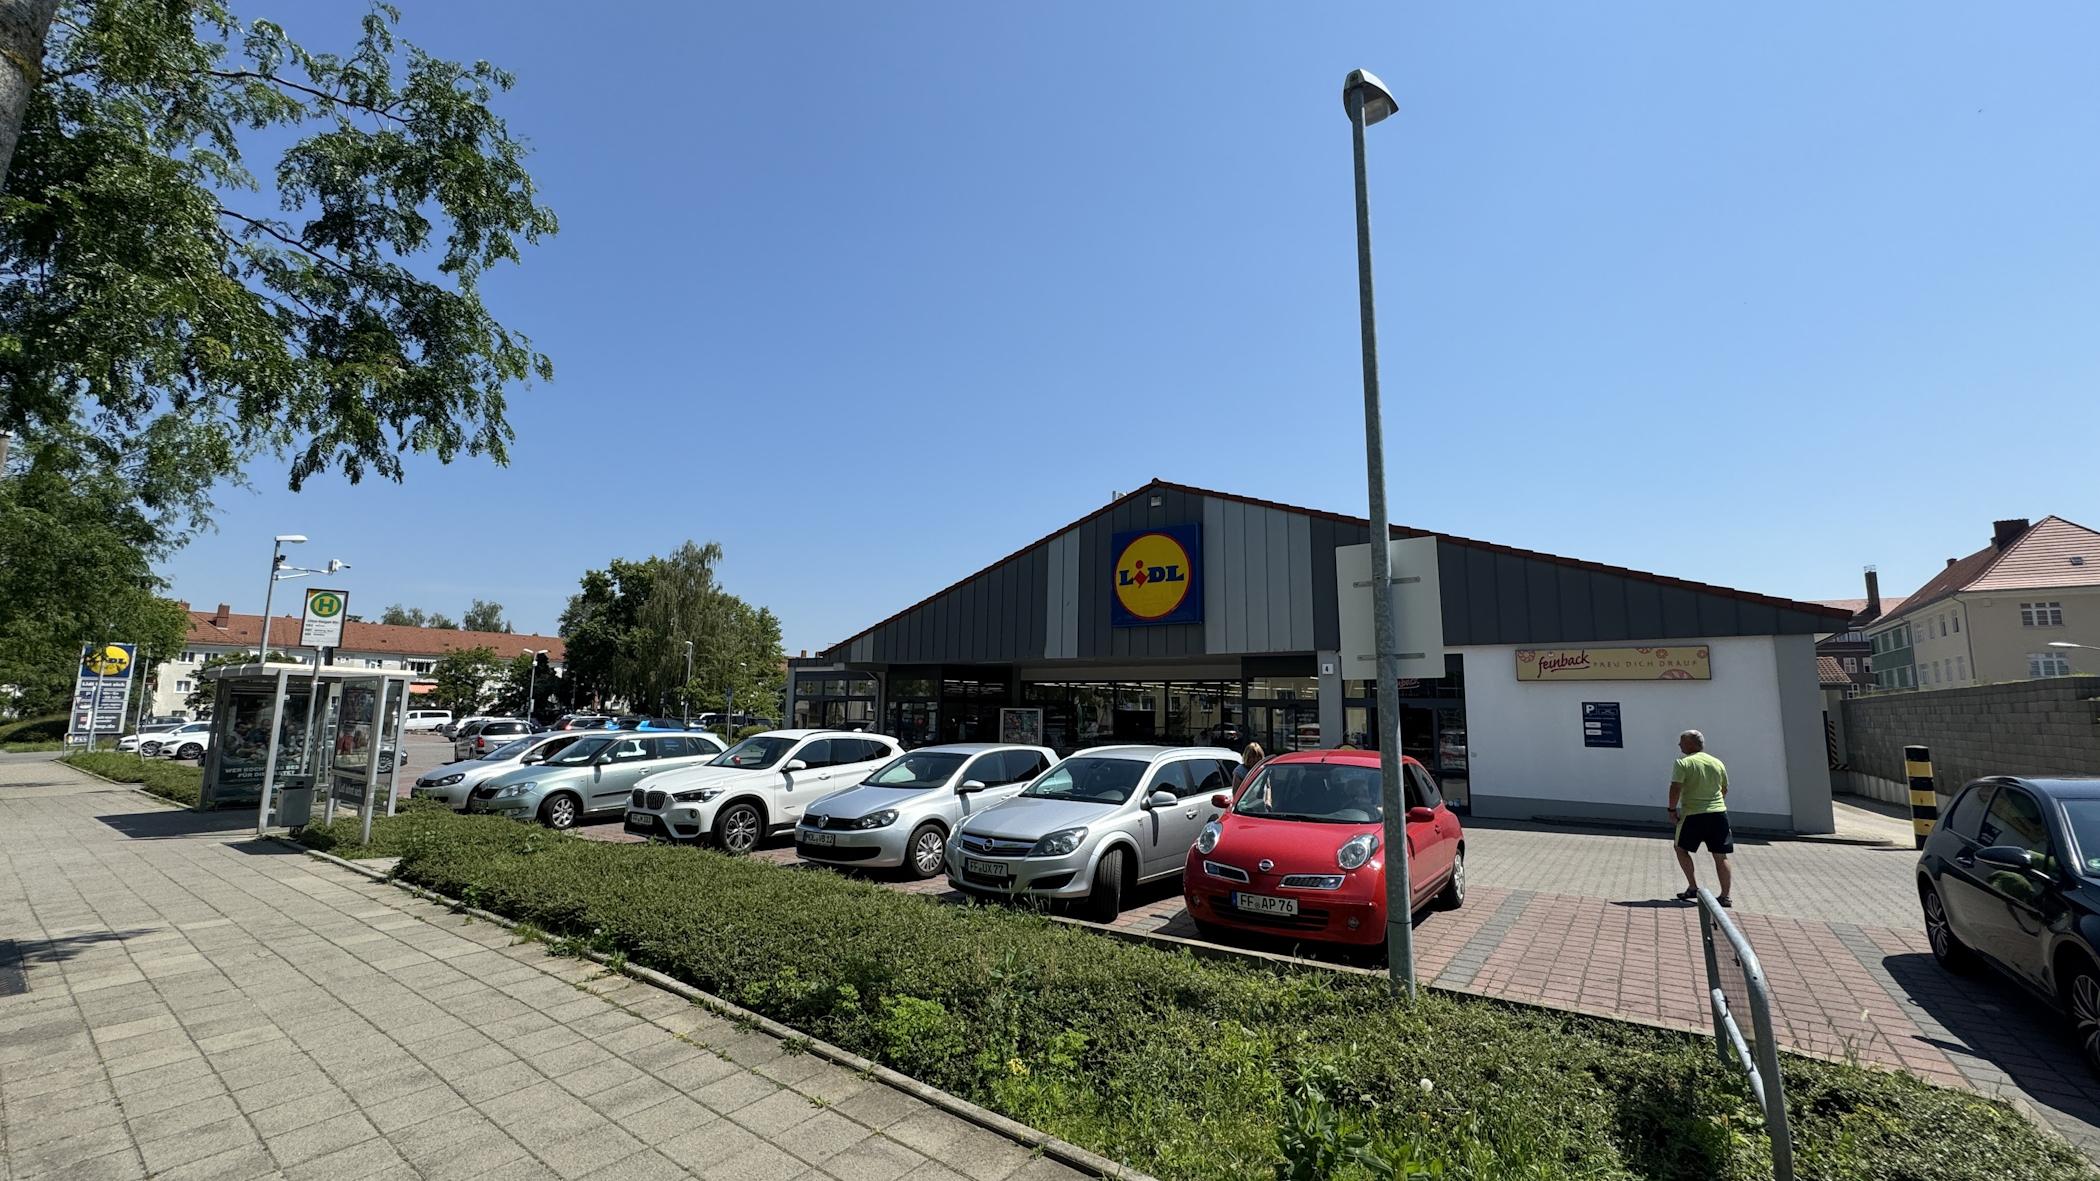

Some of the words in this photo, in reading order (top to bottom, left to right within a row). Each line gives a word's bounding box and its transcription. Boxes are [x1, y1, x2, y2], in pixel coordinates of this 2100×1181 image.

[318, 598, 335, 612] H
[1537, 650, 1590, 679] feinback
[1585, 704, 1595, 714] P
[970, 862, 979, 870] FF
[982, 864, 993, 873] UX
[993, 865, 1004, 874] 77
[1240, 895, 1255, 907] FF
[1261, 898, 1276, 910] AP
[1279, 900, 1293, 912] 76
